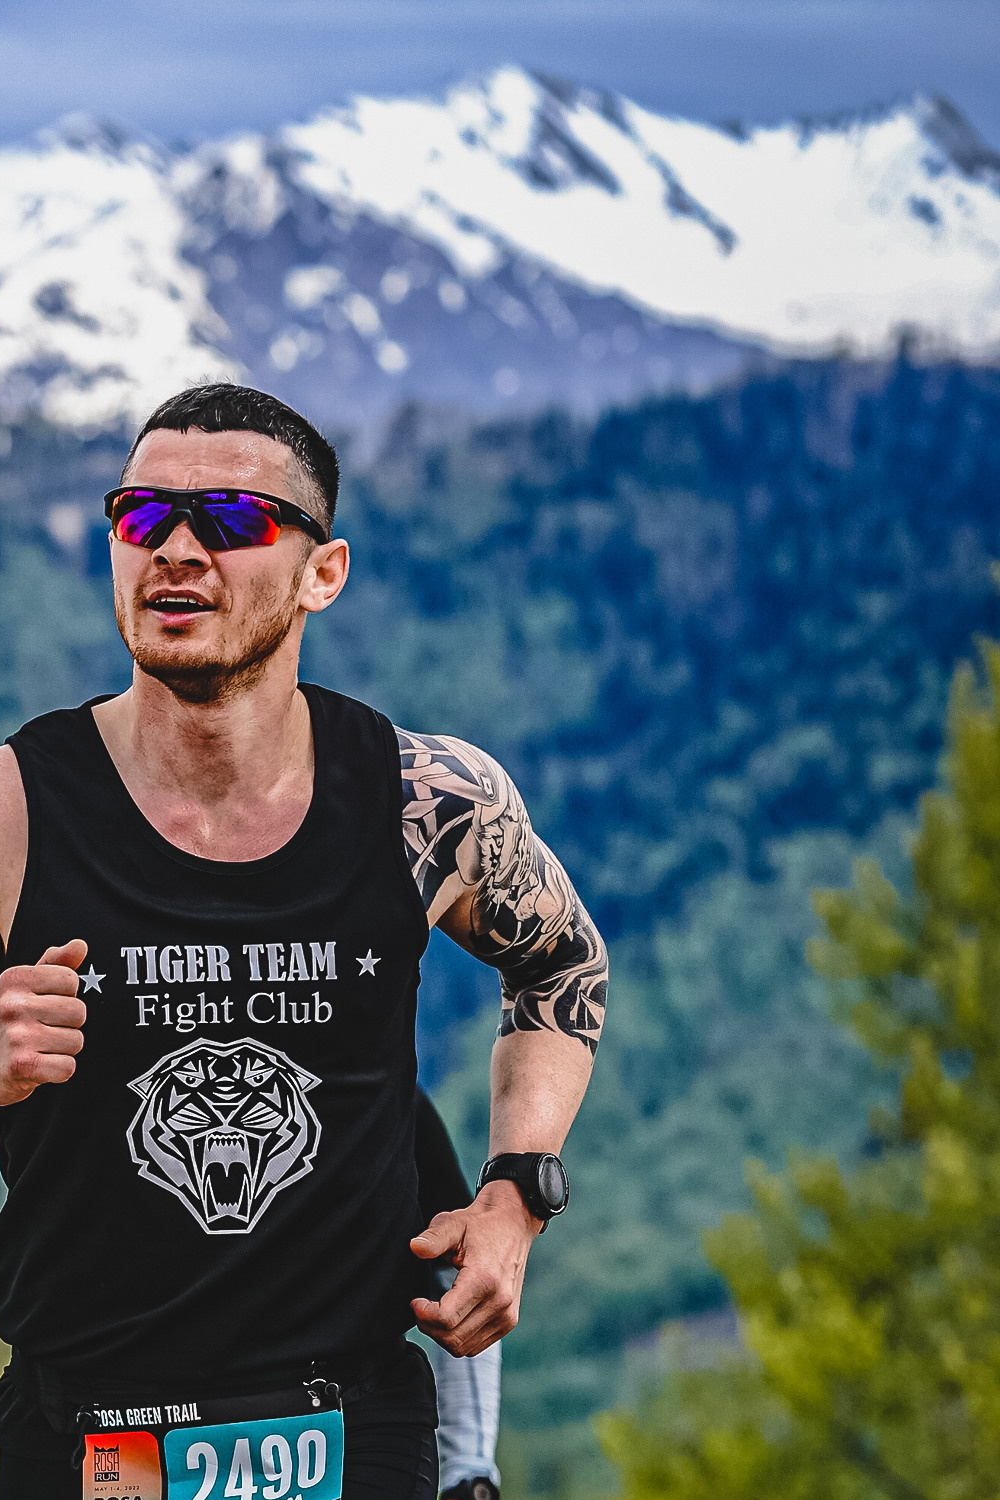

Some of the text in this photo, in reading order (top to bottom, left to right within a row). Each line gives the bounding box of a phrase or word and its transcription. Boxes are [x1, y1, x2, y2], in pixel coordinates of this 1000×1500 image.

[120, 941, 338, 985] TIGER TEAM
[134, 991, 334, 1032] Fight Club
[126, 1406, 162, 1426] GREEN
[164, 1402, 202, 1423] TRAIL
[93, 1451, 120, 1472] ROSA
[95, 1472, 118, 1481] RUN
